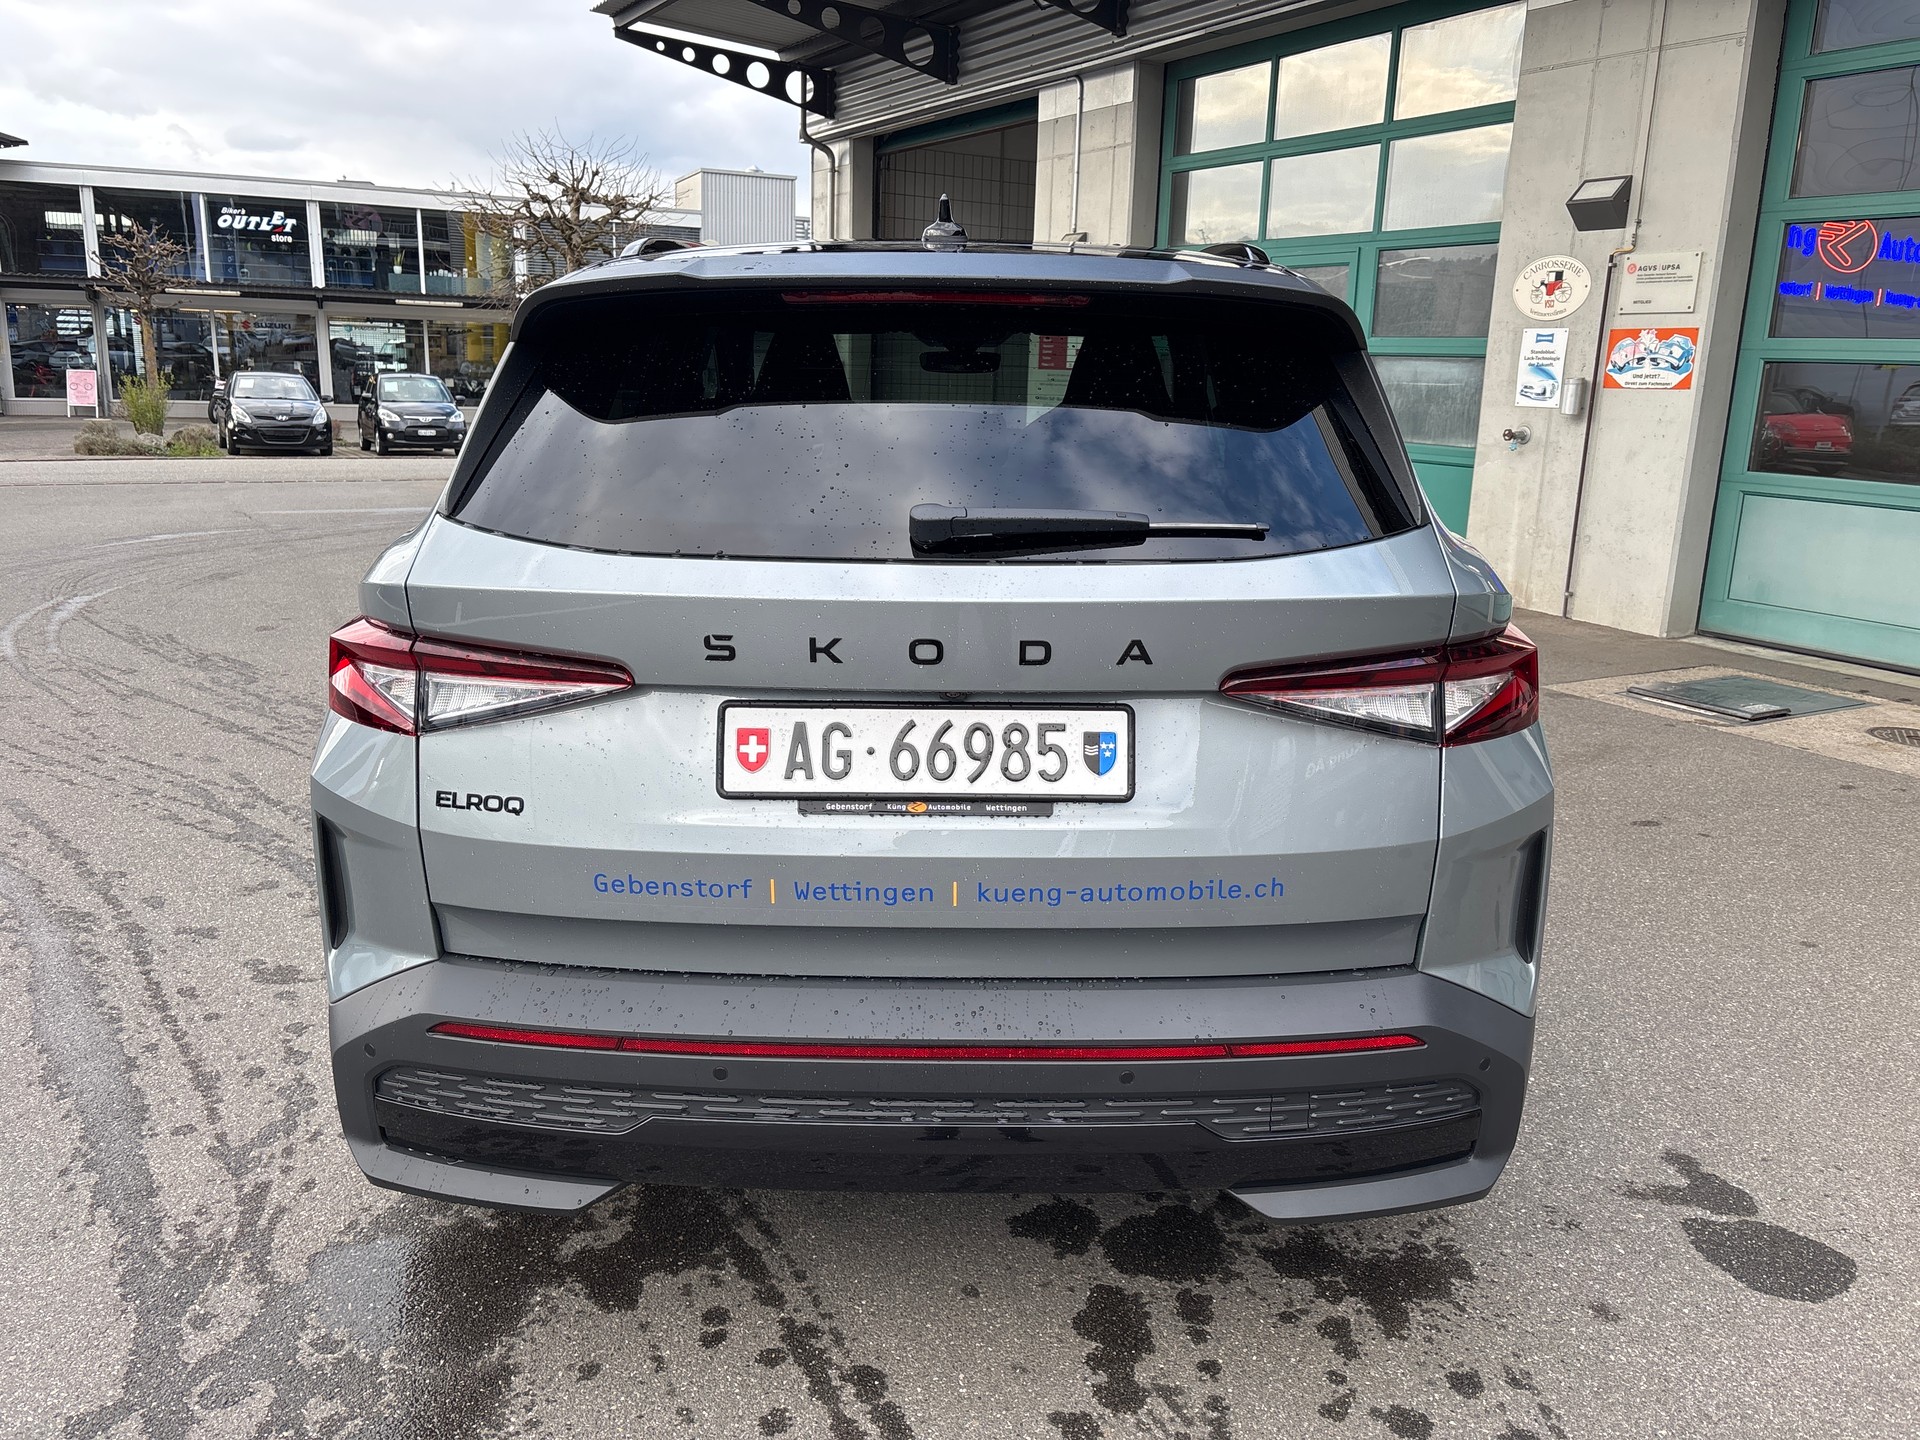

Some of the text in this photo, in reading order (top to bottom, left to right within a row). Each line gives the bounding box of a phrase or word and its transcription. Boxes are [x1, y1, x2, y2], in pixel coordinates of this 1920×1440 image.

[217, 211, 297, 233] OUTLET
[271, 234, 293, 243] store
[1523, 260, 1584, 280] CARROSSERIE
[253, 322, 291, 330] SUZUKI
[435, 790, 525, 816] ELROQ
[825, 803, 873, 811] Gebenstorf
[887, 803, 907, 812] Küng
[985, 804, 1028, 812] Wettingen
[593, 873, 1285, 907] Gebenstorf Wettingen kueng-automobile.ch
